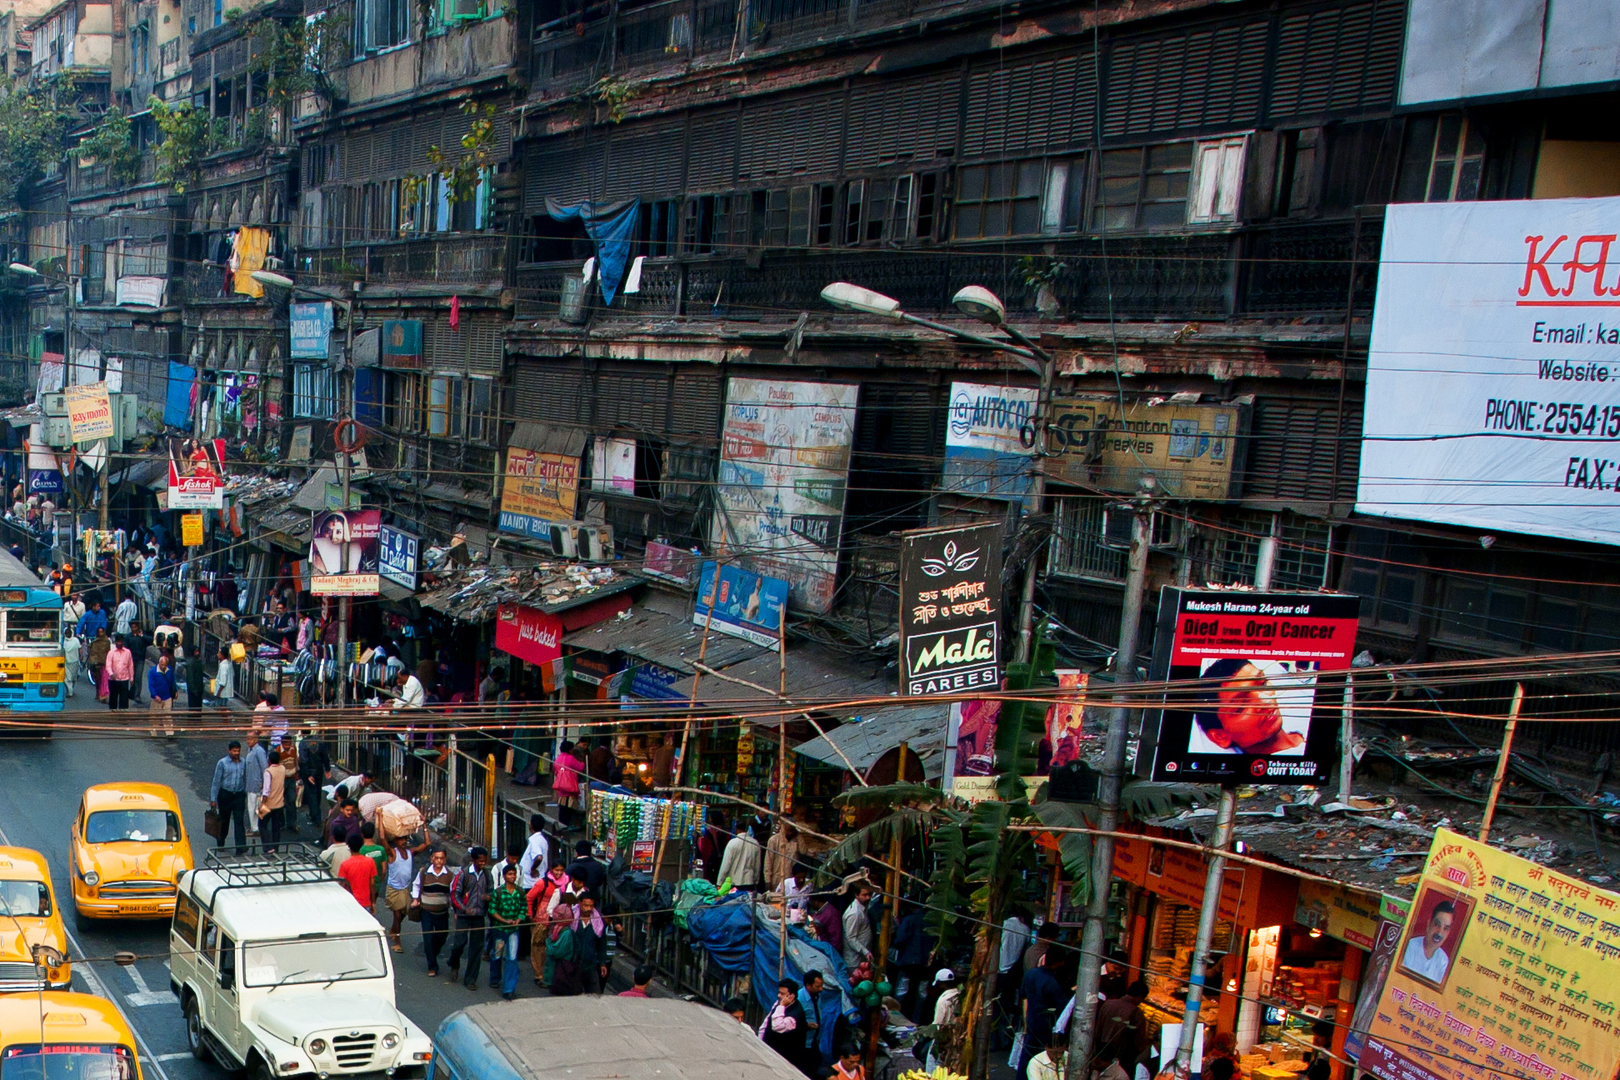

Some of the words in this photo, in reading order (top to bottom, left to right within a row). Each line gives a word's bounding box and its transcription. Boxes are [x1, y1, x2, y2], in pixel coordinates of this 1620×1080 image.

[180, 478, 212, 490] Ashok
[759, 523, 788, 535] Product
[806, 519, 829, 545] BLACK
[312, 576, 336, 584] Madanji
[337, 576, 361, 584] Meghraj
[1186, 600, 1221, 611] Mukesh
[1223, 602, 1256, 613] Harane
[1258, 603, 1294, 615] 24-year
[1294, 604, 1310, 614] old
[517, 620, 534, 642] just
[534, 623, 556, 648] baked
[1183, 618, 1219, 636] Died
[1221, 627, 1242, 636] from
[1245, 619, 1278, 638] Oral
[1280, 621, 1336, 640] Cancer
[1207, 638, 1215, 646] by
[1216, 638, 1245, 647] chewing
[913, 629, 993, 673] Mala
[912, 670, 994, 695] SAREES
[1266, 767, 1287, 776] QUIT
[1288, 767, 1317, 776] TODAY
[1528, 867, 1544, 881] श्री
[1490, 937, 1504, 950] जो
[1544, 961, 1567, 979] पास
[1570, 970, 1581, 986] है
[1499, 957, 1513, 972] वह
[1540, 993, 1556, 1010] और
[1391, 986, 1408, 1002] एक
[1443, 1009, 1474, 1037] विशाल
